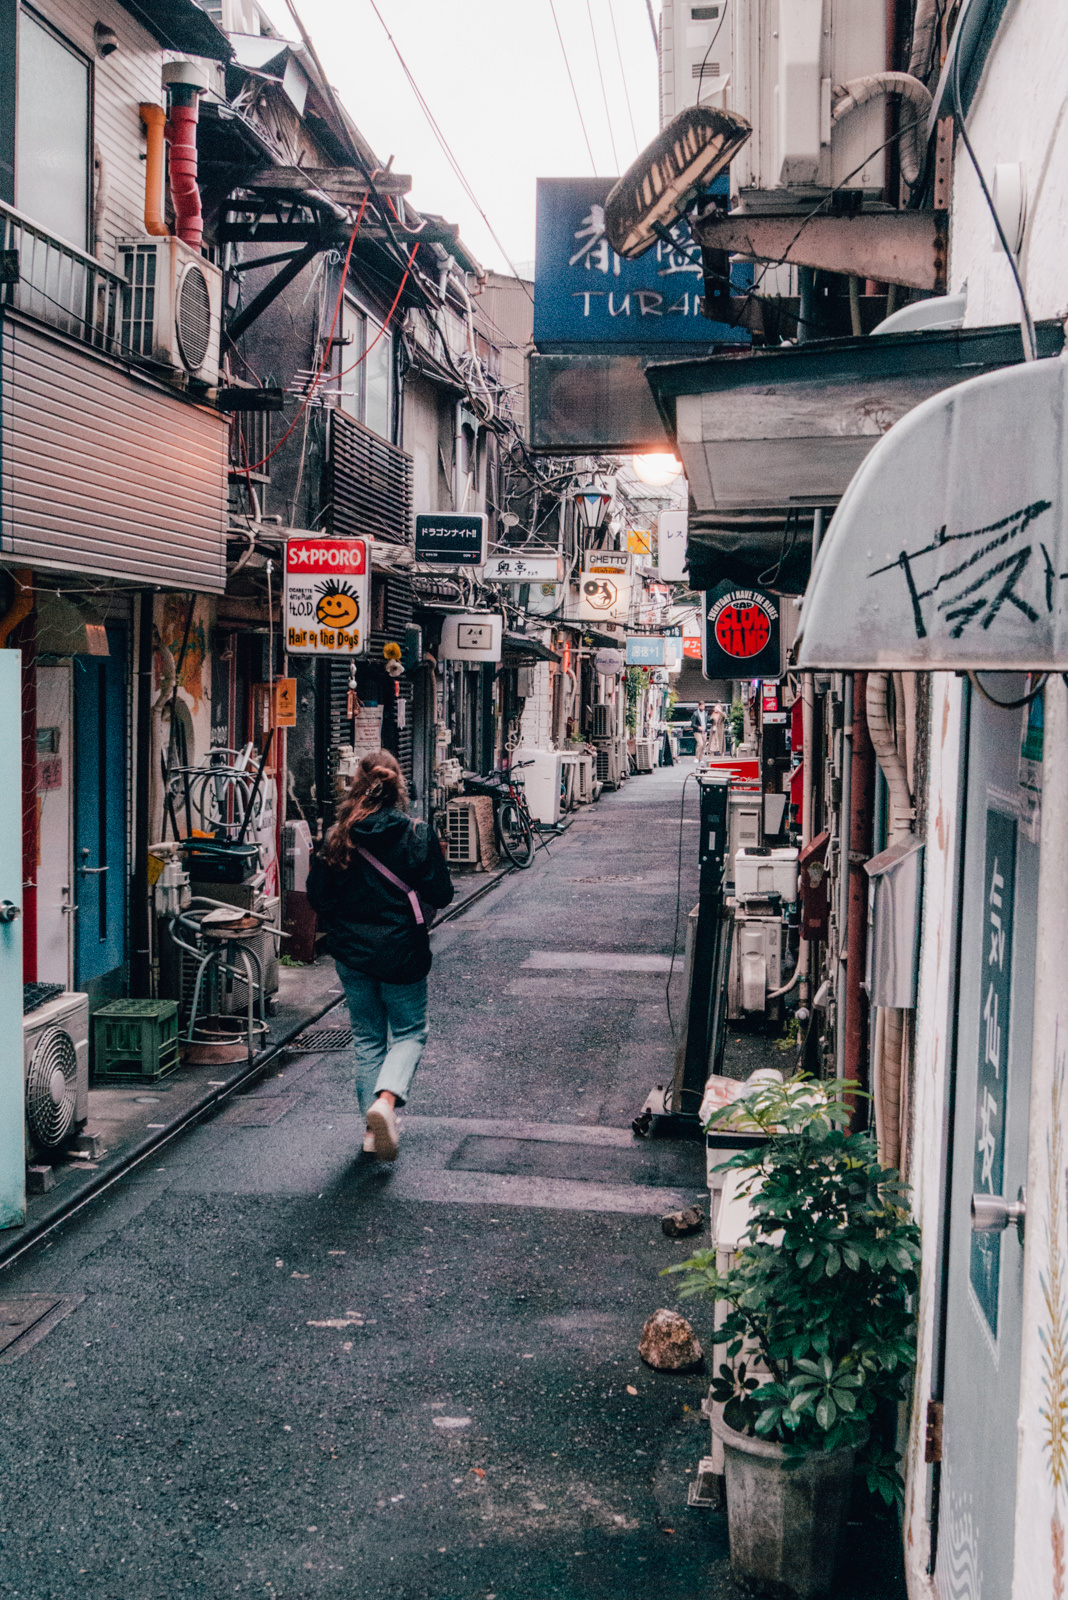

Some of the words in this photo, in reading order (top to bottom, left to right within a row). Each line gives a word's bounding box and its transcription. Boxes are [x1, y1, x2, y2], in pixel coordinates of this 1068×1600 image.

[589, 554, 628, 565] GHETTO
[707, 593, 732, 622] EVERYDAY
[731, 591, 736, 600] I
[735, 590, 753, 600] HAVE
[752, 592, 766, 605] THE
[761, 601, 779, 621] BLUES
[717, 605, 769, 631] SLOW
[288, 628, 308, 646] Hair
[309, 633, 318, 648] of
[320, 629, 335, 645] the
[337, 631, 359, 649] Dogs
[717, 629, 769, 657] HAND
